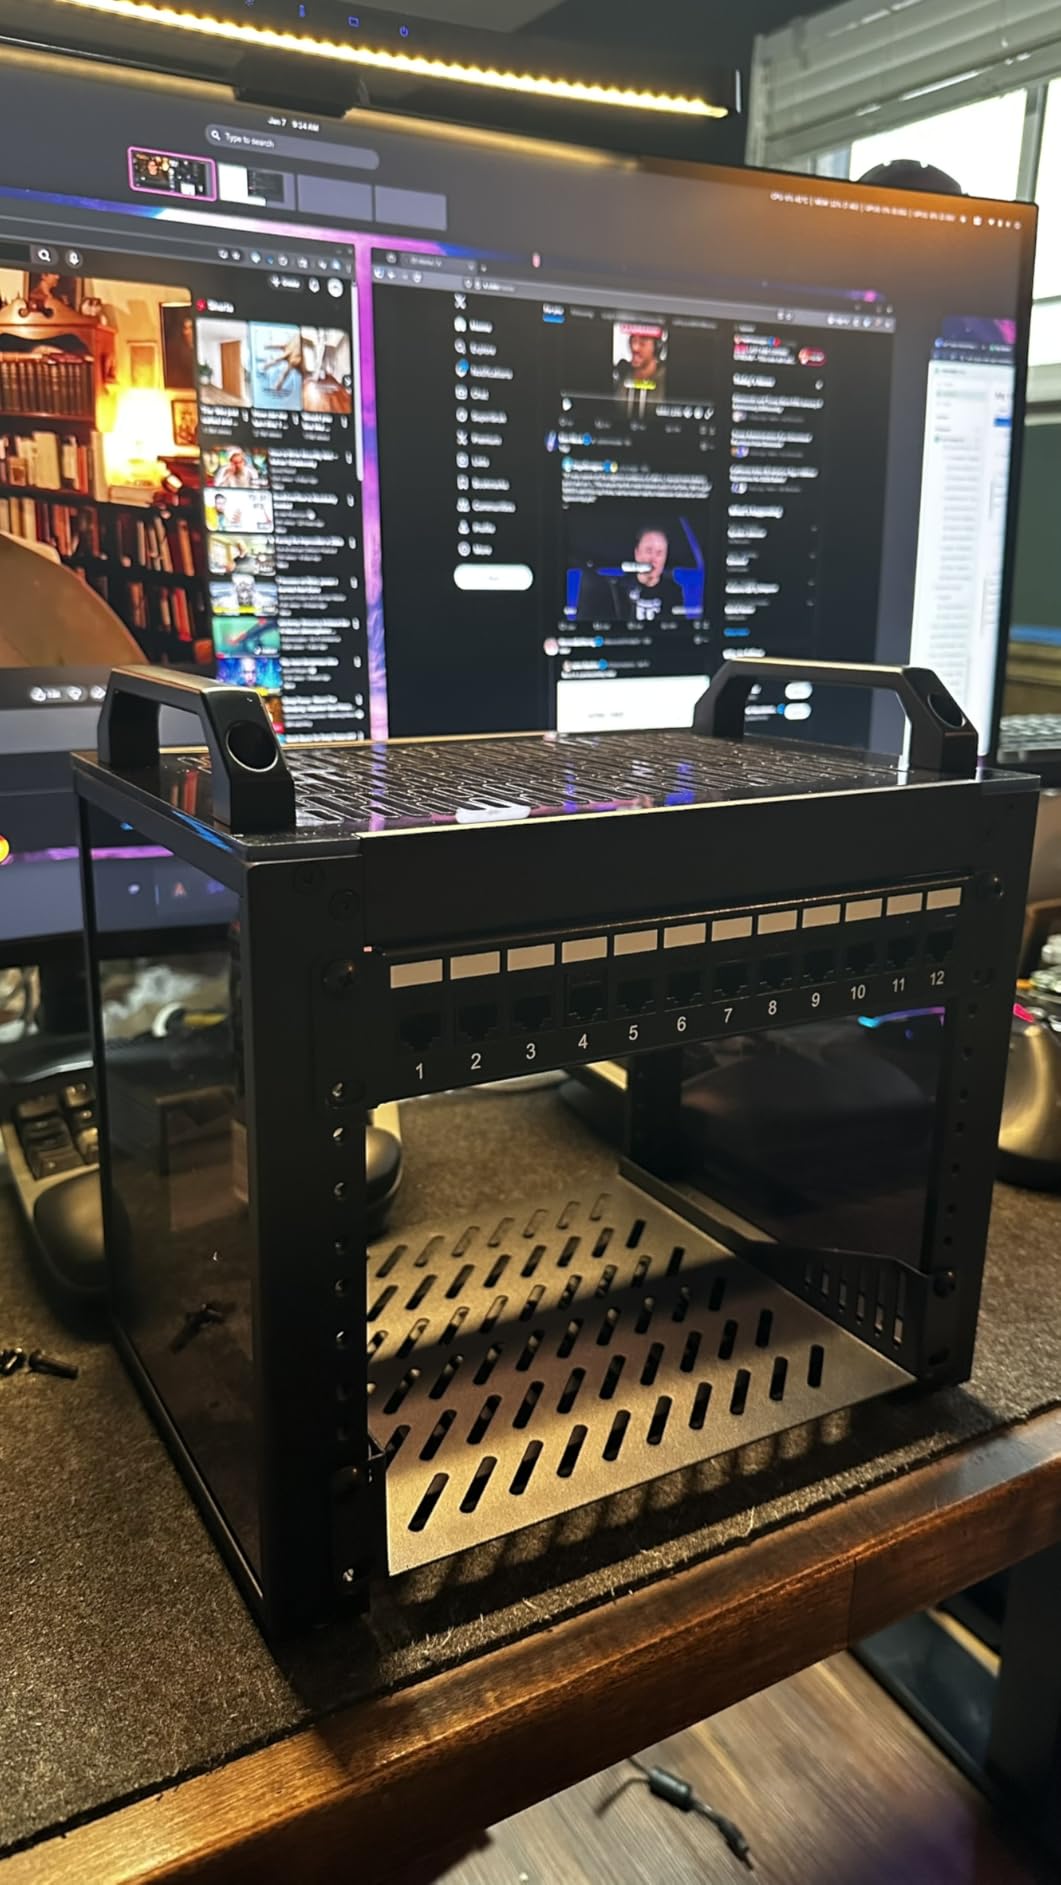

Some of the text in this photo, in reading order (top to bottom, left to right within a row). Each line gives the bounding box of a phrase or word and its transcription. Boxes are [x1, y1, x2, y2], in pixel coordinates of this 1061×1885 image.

[415, 970, 945, 1080] 1 2 3 4 5 6 7 8 9 10 11 12
